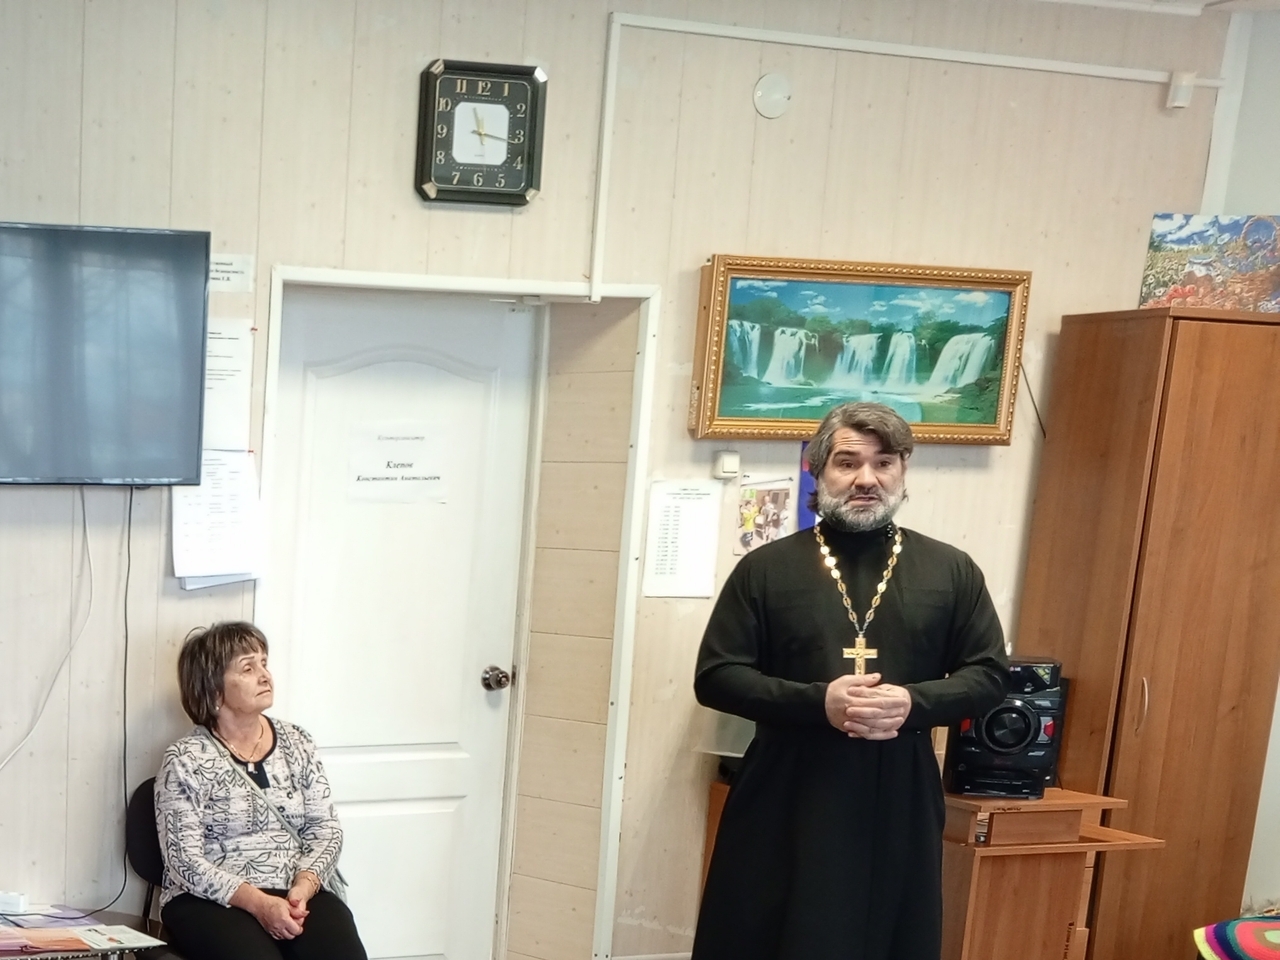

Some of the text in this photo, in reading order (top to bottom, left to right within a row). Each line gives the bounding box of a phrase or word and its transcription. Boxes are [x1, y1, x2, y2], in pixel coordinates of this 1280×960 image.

[456, 79, 467, 94] 11
[477, 81, 491, 96] 12
[503, 83, 510, 96] 1
[438, 98, 452, 112] 10
[517, 103, 526, 118] 2
[437, 124, 448, 138] 9
[515, 130, 525, 144] 3
[436, 150, 445, 165] 8
[513, 156, 524, 170] 4
[451, 171, 461, 185] 7
[473, 173, 483, 187] 6
[495, 174, 506, 188] 5
